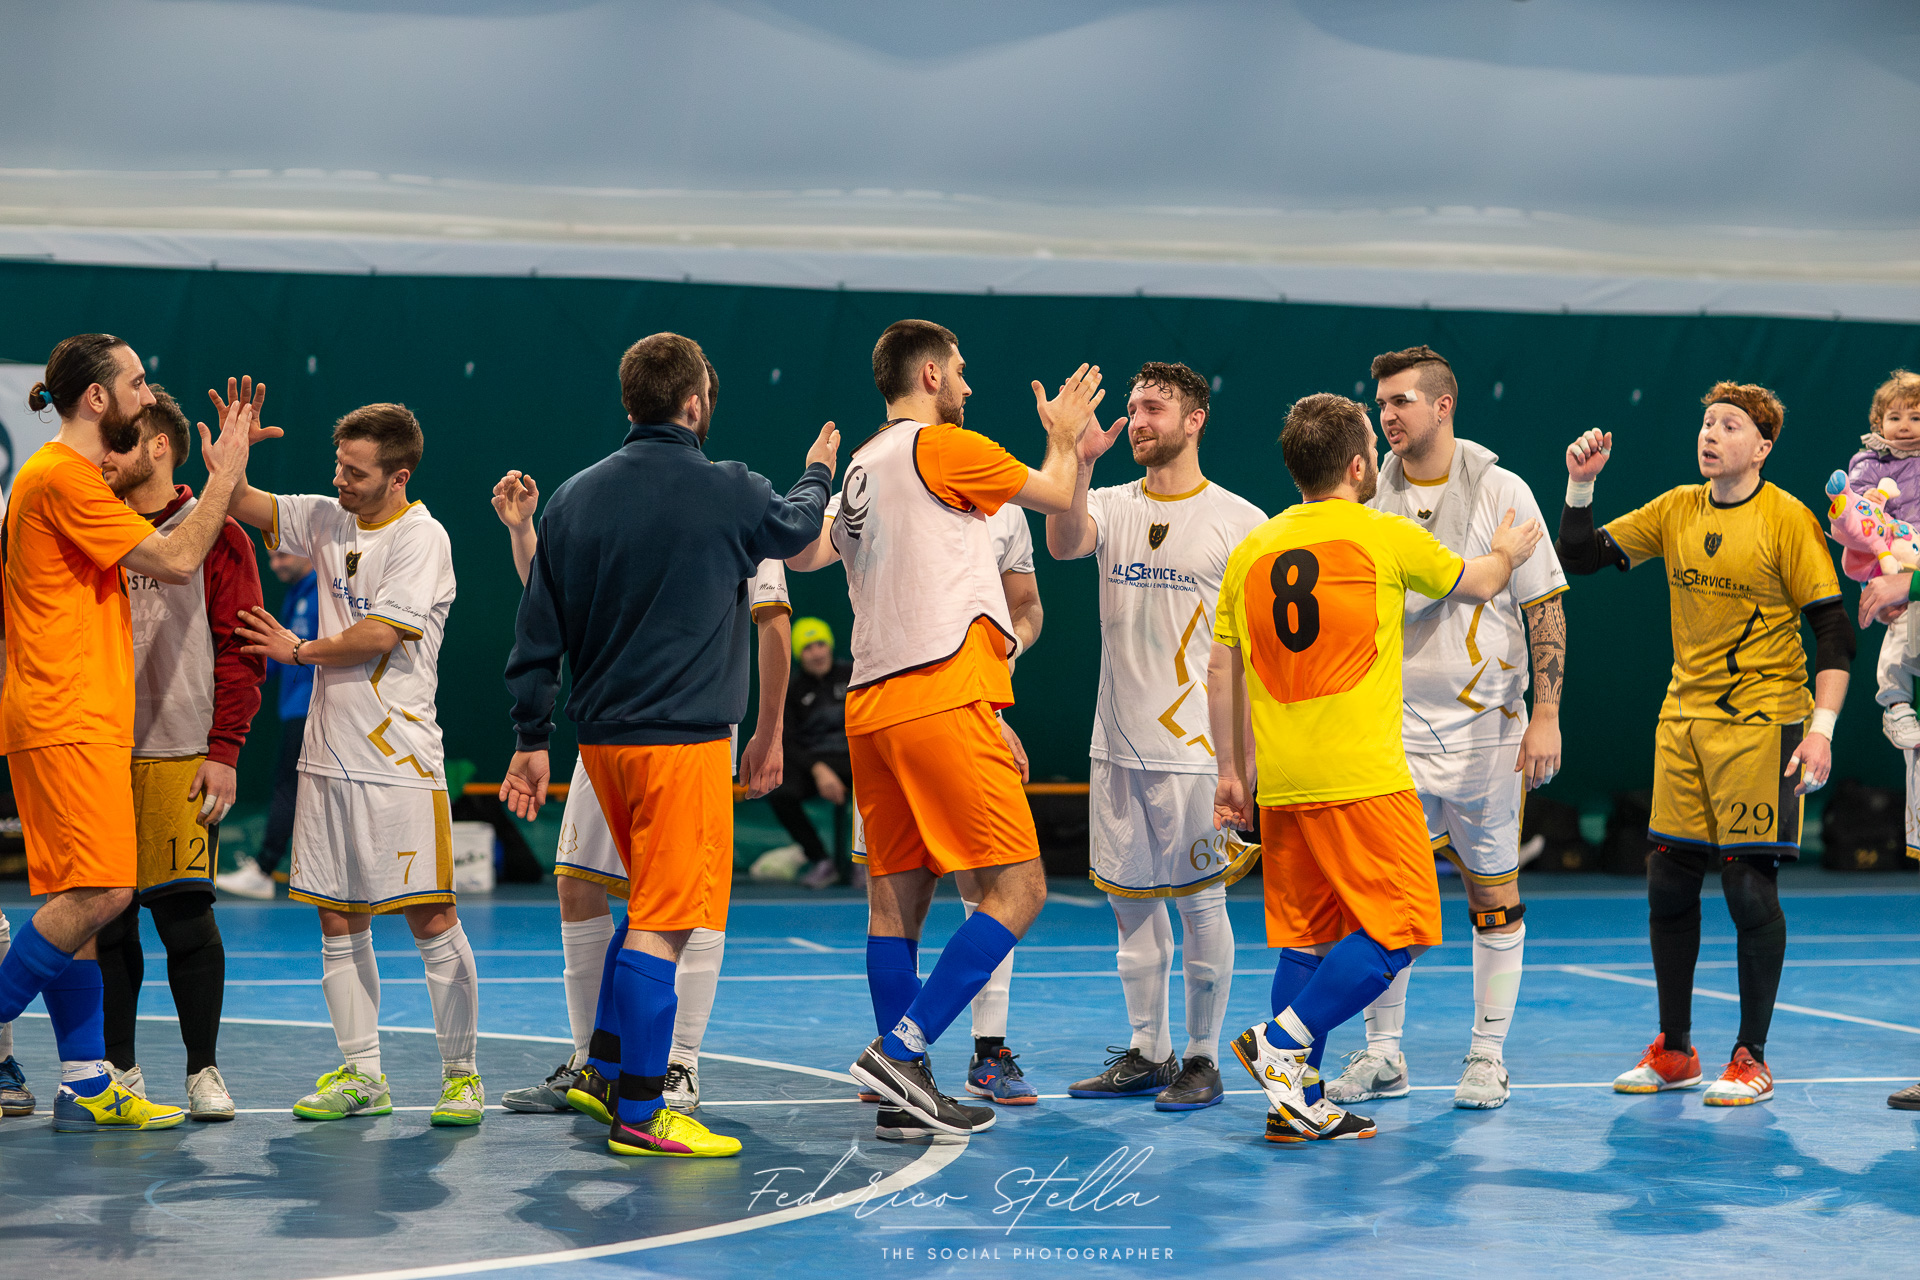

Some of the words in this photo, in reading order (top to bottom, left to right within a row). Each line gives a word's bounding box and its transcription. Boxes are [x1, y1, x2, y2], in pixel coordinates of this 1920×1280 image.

[1270, 549, 1320, 653] 8
[1728, 801, 1775, 836] 29
[167, 836, 207, 873] 12
[397, 850, 418, 885] 7
